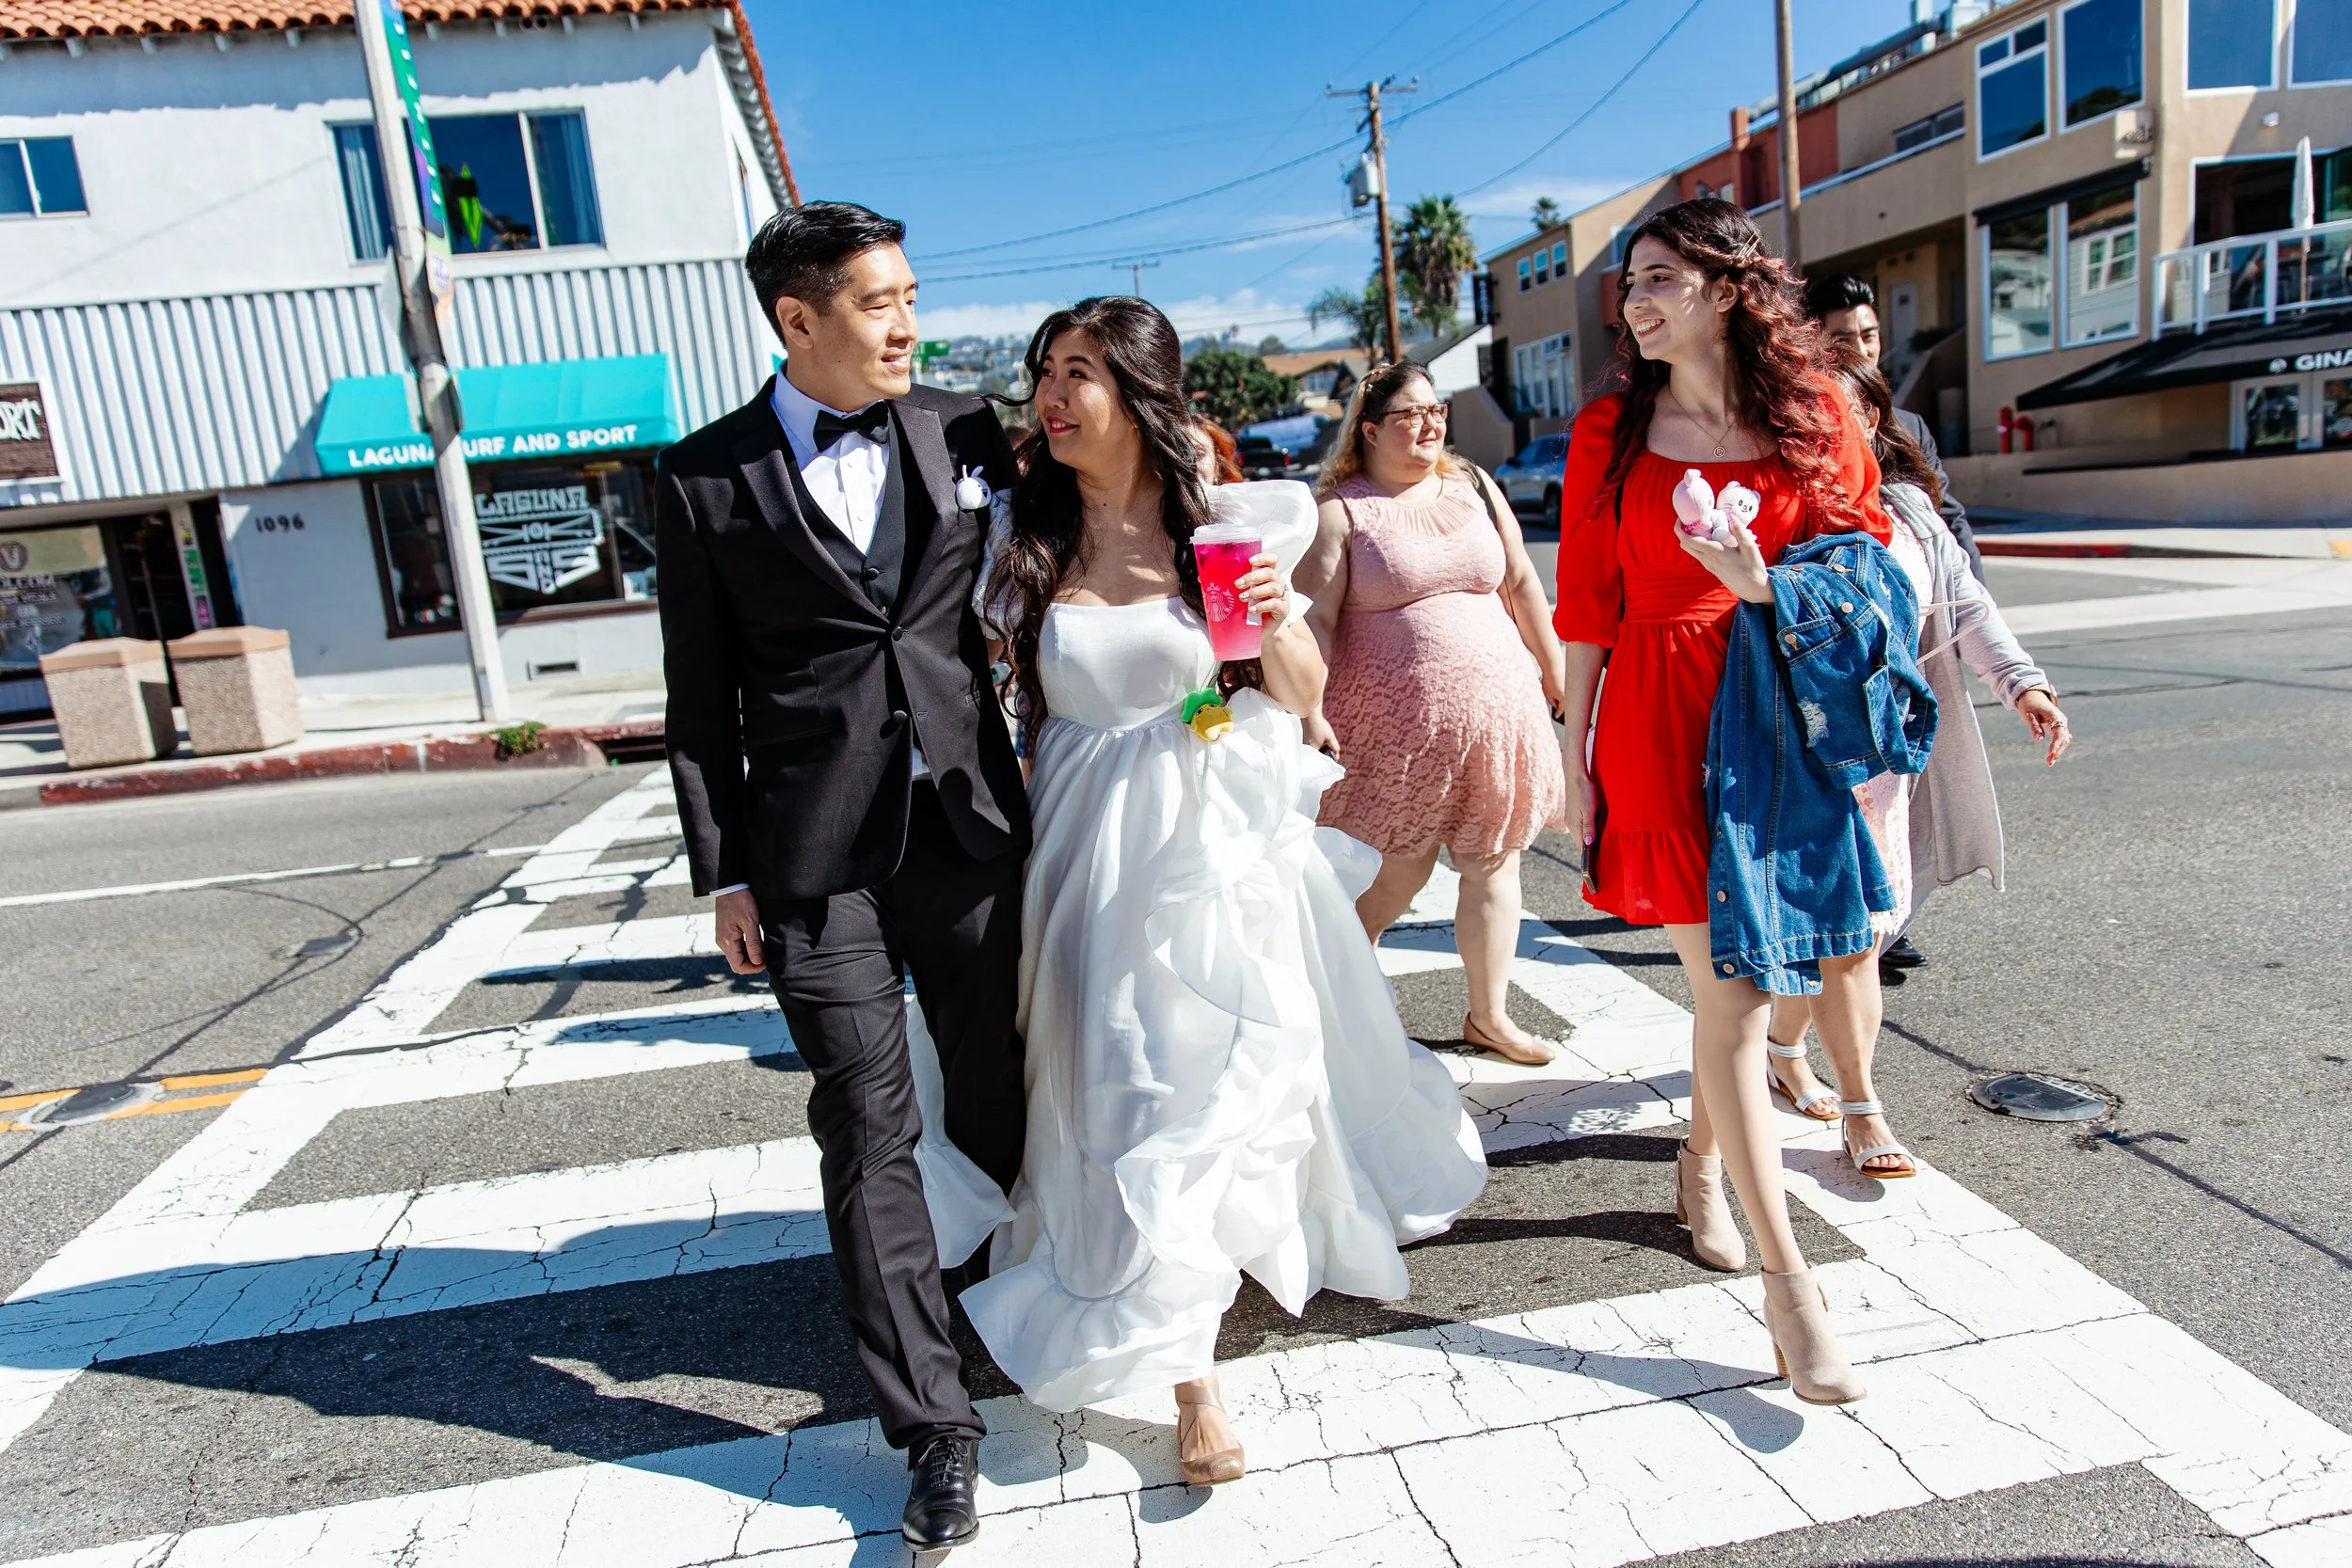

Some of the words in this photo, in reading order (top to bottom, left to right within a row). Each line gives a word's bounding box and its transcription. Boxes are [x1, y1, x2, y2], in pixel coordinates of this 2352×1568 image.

[462, 436, 505, 458] URF
[513, 432, 561, 453] AND
[566, 423, 637, 450] SPORT
[474, 485, 591, 517] LAGUNA
[255, 513, 305, 534] 1096
